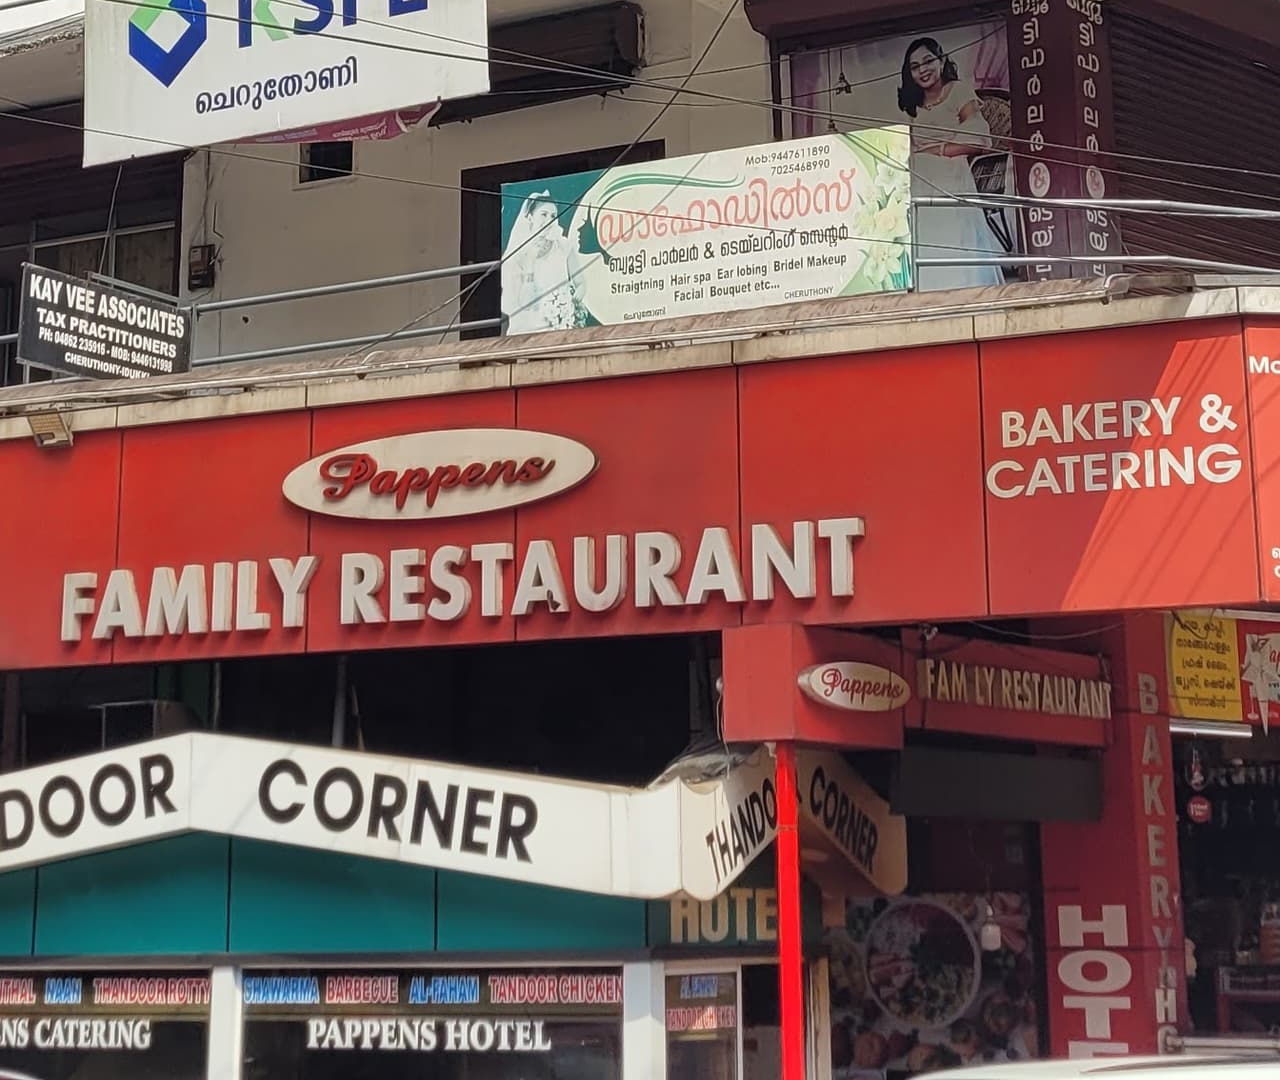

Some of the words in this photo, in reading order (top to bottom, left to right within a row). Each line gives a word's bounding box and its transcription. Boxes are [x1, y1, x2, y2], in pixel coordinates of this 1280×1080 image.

[195, 56, 358, 115] ചെറുതോണി
[745, 145, 831, 166] Mob:9447611890
[770, 159, 831, 177] 7025468990
[599, 168, 857, 247] ഡാഫോഡിൽസ്
[611, 278, 665, 295] Straigtning
[670, 273, 691, 287] Hair
[693, 272, 711, 285] spa
[717, 268, 734, 280] Ear
[736, 264, 767, 279] lobing
[774, 258, 803, 272] Bridel
[807, 253, 847, 268] Makeup
[650, 242, 699, 268] പാർലർ
[703, 241, 715, 260] &
[30, 273, 63, 304] KAY
[66, 283, 95, 314] VEE
[98, 294, 184, 338] ASSOCIATES
[674, 289, 704, 302] Facial
[710, 282, 751, 298] Bouquet
[784, 286, 834, 300] CHERUTHONY
[37, 308, 66, 329] TAX
[70, 316, 176, 359] PRACTITIONERS
[39, 326, 53, 342] PH:
[111, 346, 130, 362] MOB:
[1001, 395, 1182, 448] BAKERY
[1198, 393, 1238, 434] &
[319, 451, 556, 511] Pappens
[986, 443, 1242, 499] CATERING
[60, 554, 318, 643] FAMILY
[339, 516, 866, 627] RESTAURANT
[821, 667, 904, 705] Pappens
[1000, 667, 1112, 720] RESTAURANT
[258, 758, 539, 865] CORNER
[809, 767, 879, 875] CORNER
[43, 977, 82, 1005] NAAN
[93, 976, 167, 1004] THANDOOR
[167, 976, 213, 1004] ROTTY
[243, 975, 320, 1004] SHAWARMA
[488, 974, 558, 1004] TANDOOR
[561, 975, 622, 1004] CHICKEN
[34, 1016, 152, 1050] CATERING
[306, 1019, 437, 1051] PAPPENS
[443, 1019, 552, 1051] HOTEL
